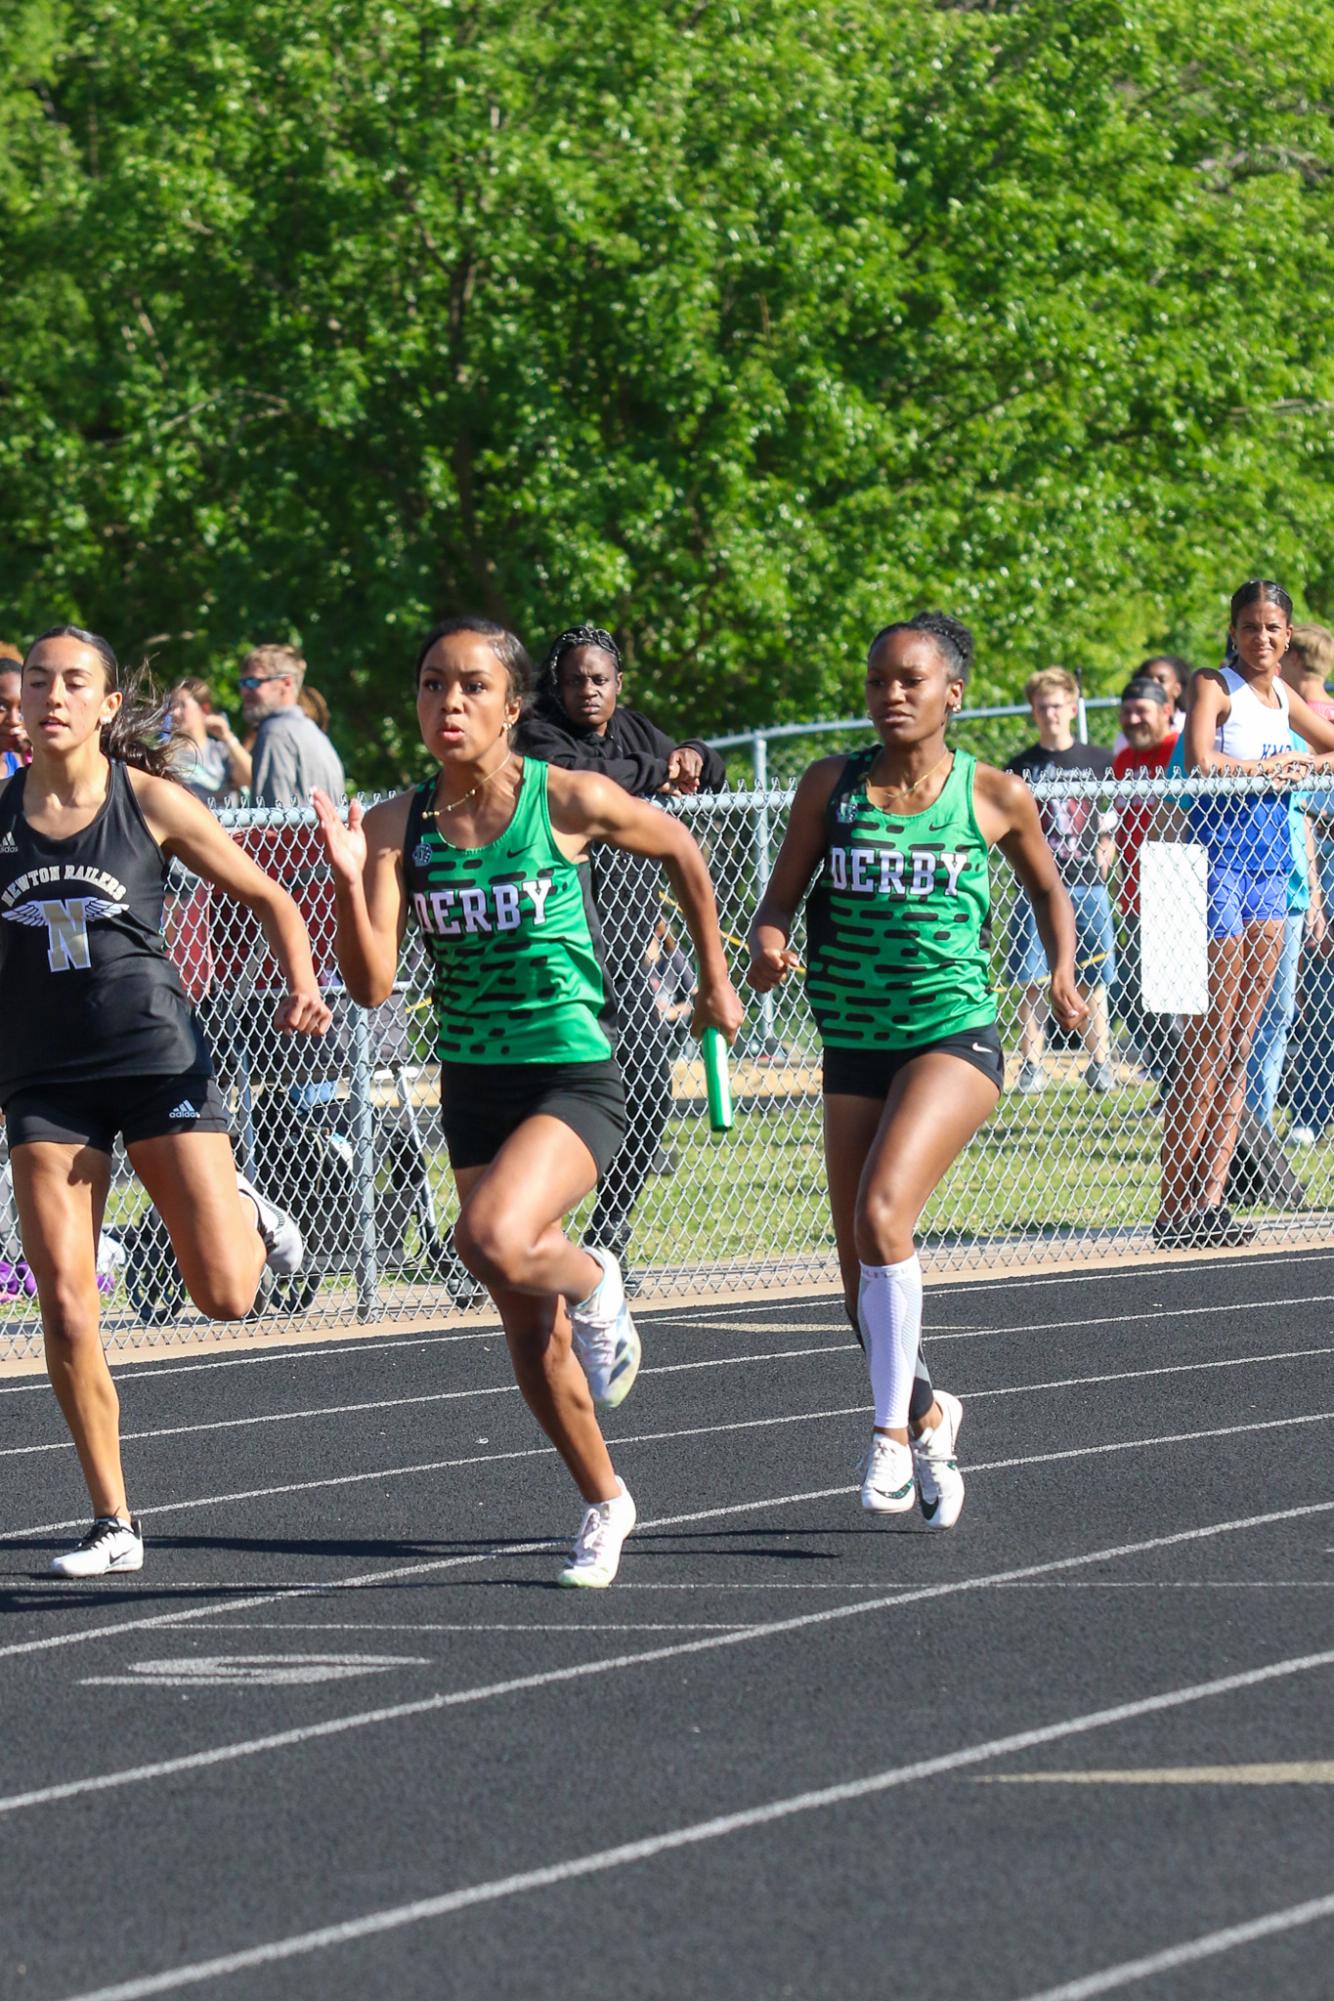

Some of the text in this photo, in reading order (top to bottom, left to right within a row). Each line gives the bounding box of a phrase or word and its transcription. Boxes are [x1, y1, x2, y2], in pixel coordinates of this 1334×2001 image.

[1, 865, 127, 907] NEWTON RAILERS
[832, 847, 967, 896] DERBY
[412, 878, 552, 935] DERBY
[40, 898, 92, 972] N
